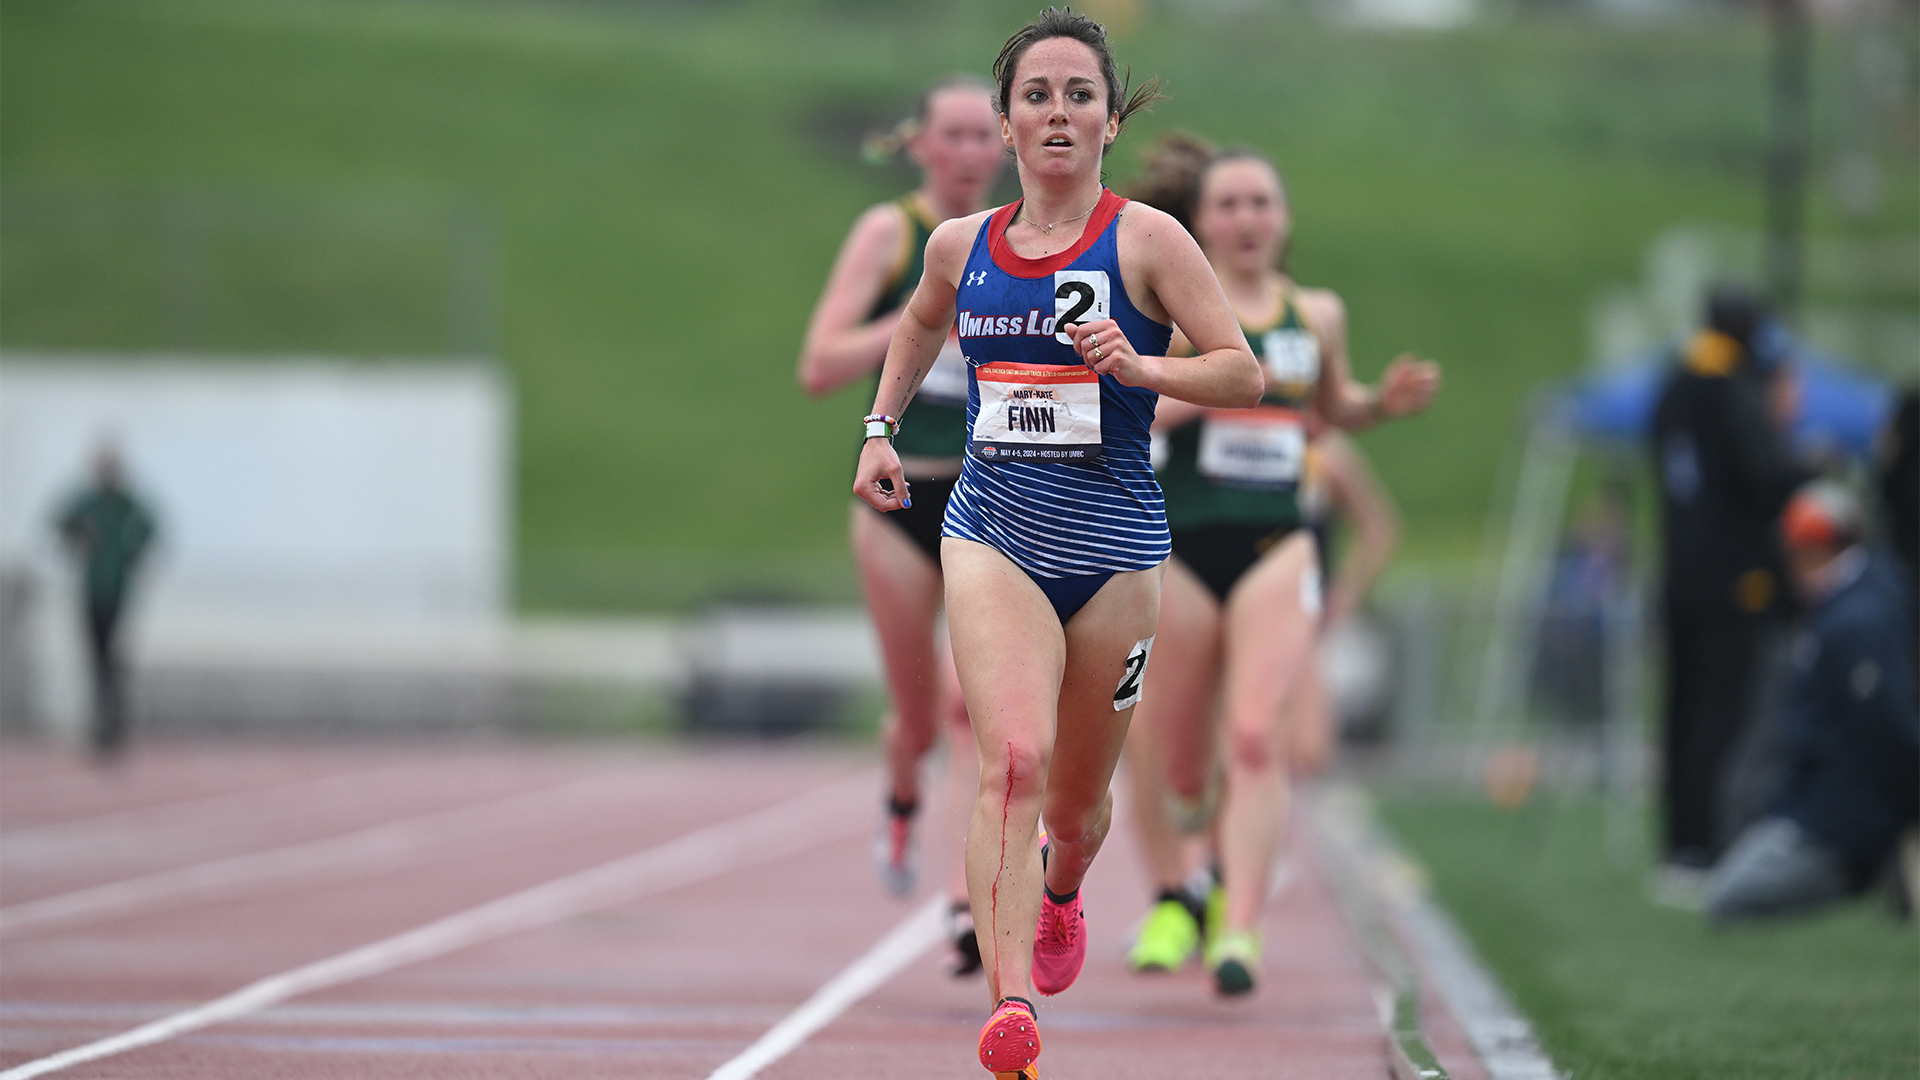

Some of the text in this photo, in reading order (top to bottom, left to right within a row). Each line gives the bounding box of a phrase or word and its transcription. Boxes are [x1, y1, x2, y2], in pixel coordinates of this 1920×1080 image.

[1055, 281, 1095, 333] 2
[1013, 390, 1054, 399] MARY-KATE
[1008, 405, 1056, 432] FINN
[1012, 449, 1022, 458] 4-5,
[1023, 449, 1036, 457] 2024
[1040, 450, 1061, 458] HOSTED
[1061, 450, 1068, 458] BY
[1069, 450, 1085, 458] UMBC
[1114, 649, 1146, 701] 2
